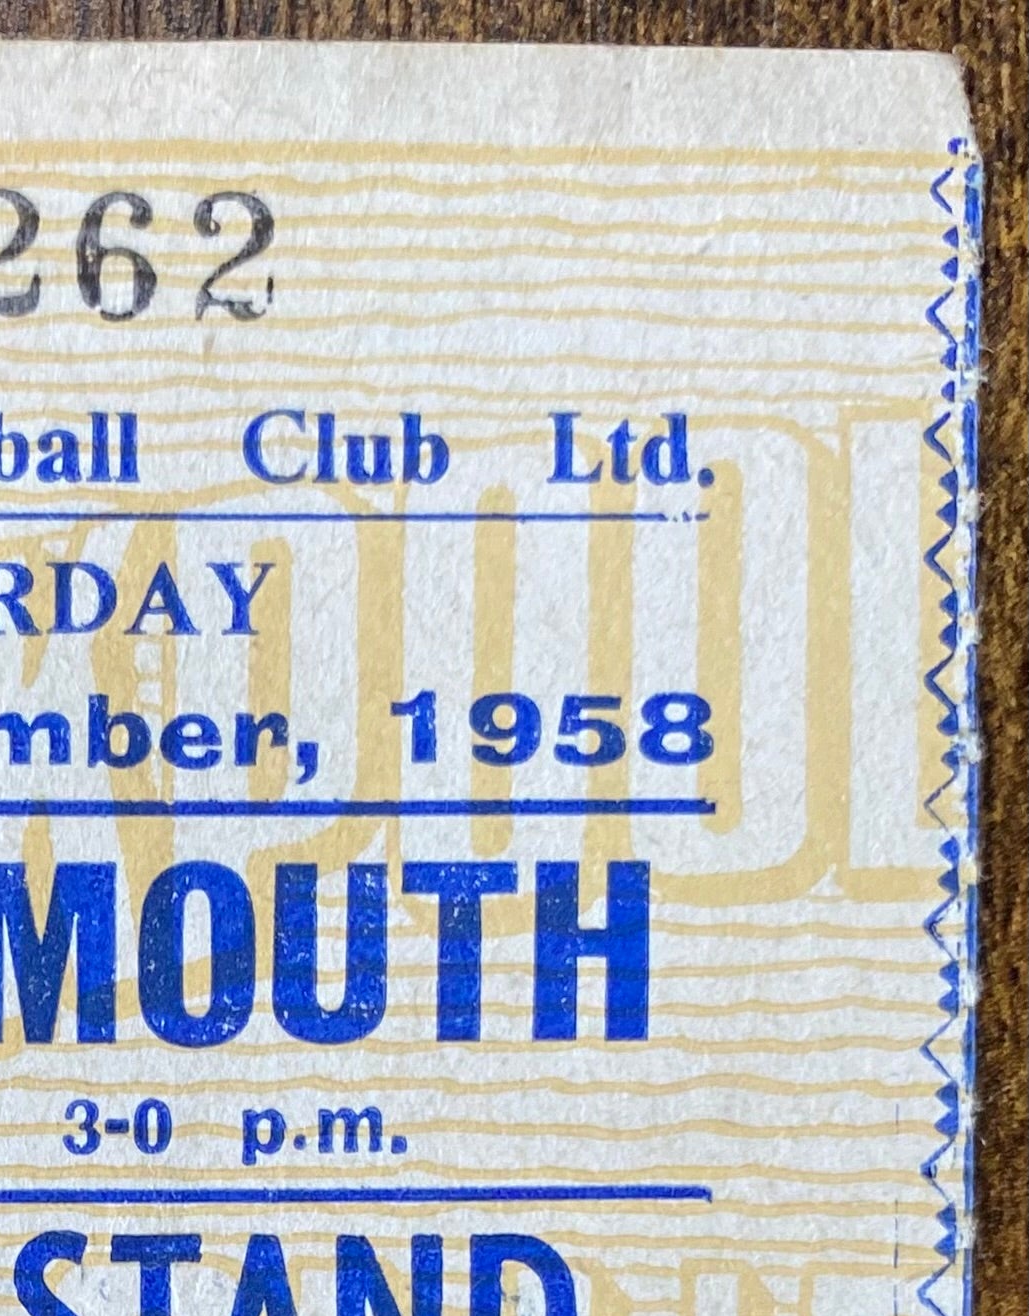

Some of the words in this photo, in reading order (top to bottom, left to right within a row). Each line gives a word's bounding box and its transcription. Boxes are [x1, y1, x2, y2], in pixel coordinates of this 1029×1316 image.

[242, 409, 451, 485] Club
[548, 412, 716, 487] Ltd.
[389, 689, 715, 768] 1958
[61, 1097, 174, 1157] 3-0
[240, 1105, 409, 1168] p.m.
